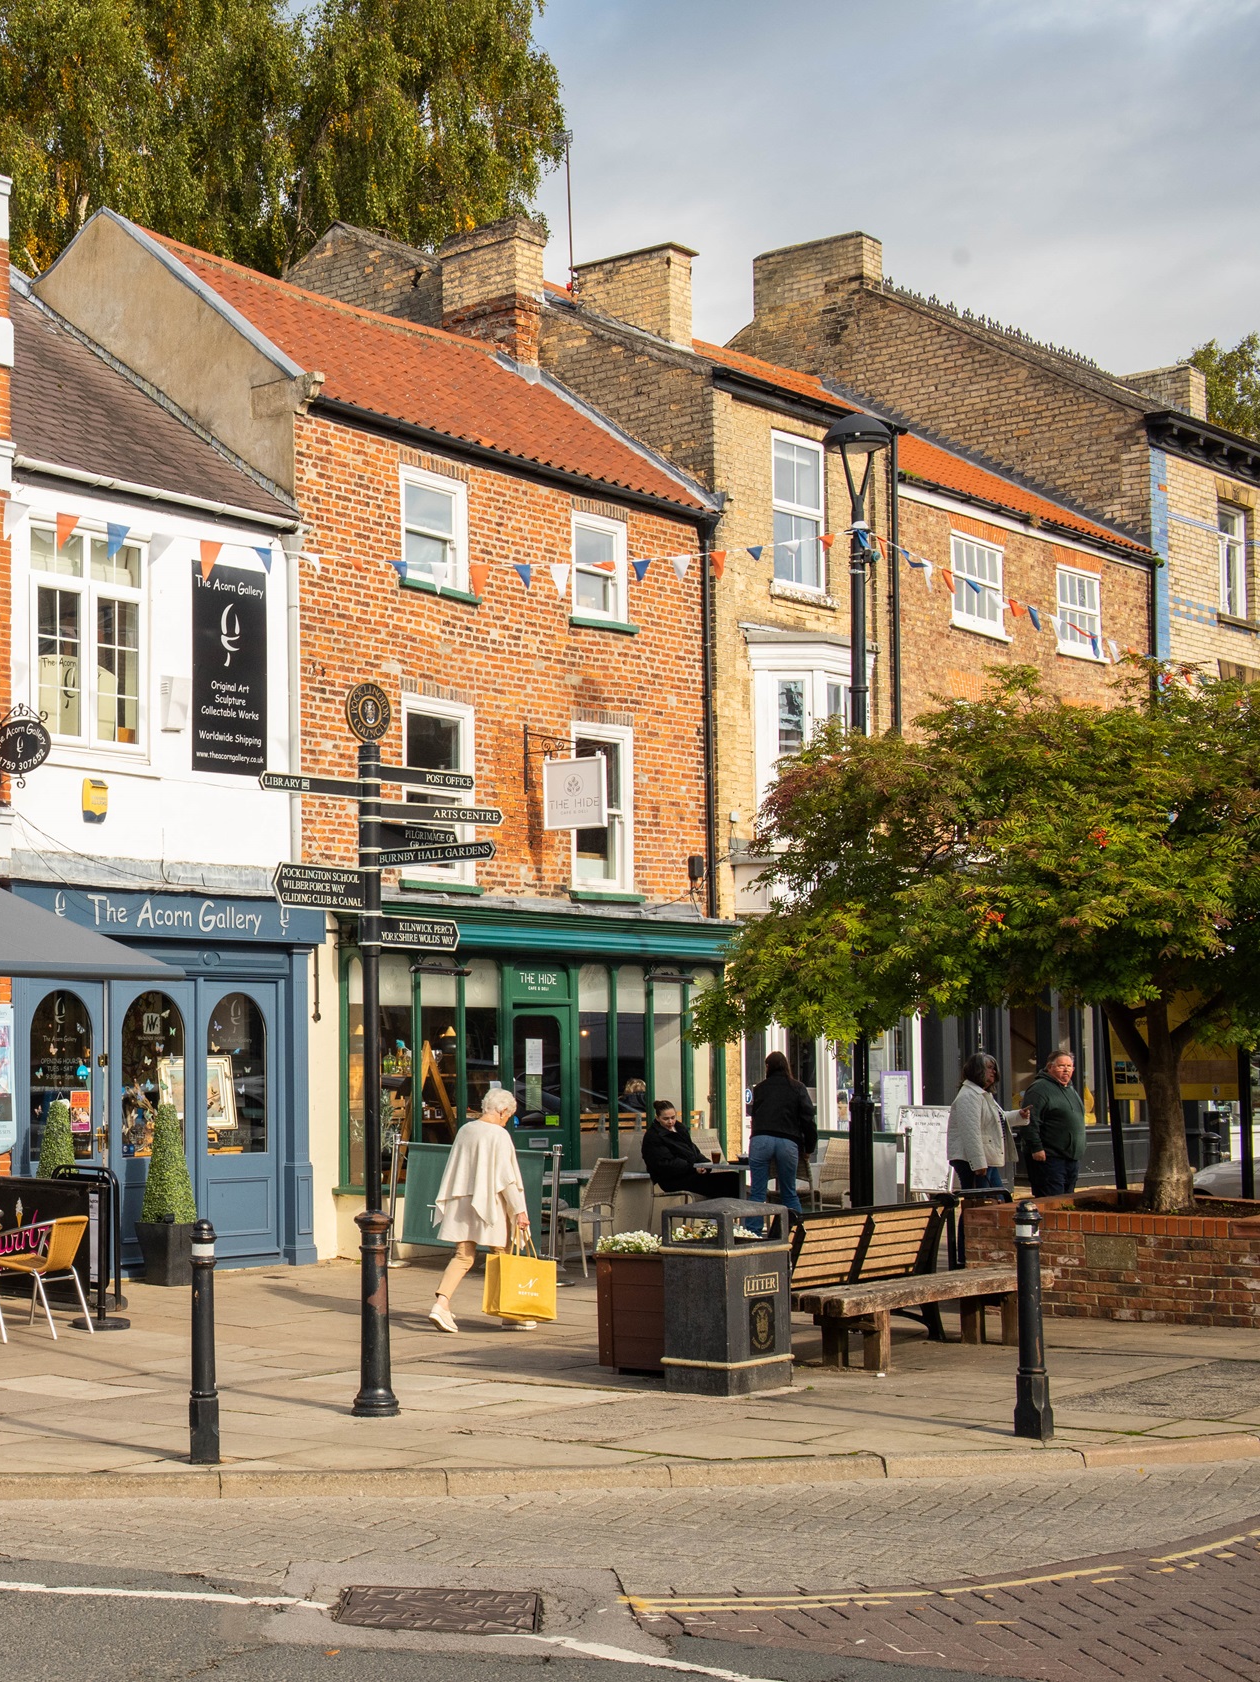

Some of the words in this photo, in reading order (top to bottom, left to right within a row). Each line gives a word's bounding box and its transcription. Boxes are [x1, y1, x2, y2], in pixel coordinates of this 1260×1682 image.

[195, 574, 211, 589] The
[213, 578, 236, 593] Acorn
[237, 581, 264, 599] Gallery
[41, 657, 56, 667] The
[59, 657, 77, 667] Acorn
[211, 680, 237, 693] Original
[238, 684, 250, 694] Art
[214, 694, 247, 706] Sculpture
[351, 685, 390, 719] POCKLINGTON
[201, 705, 237, 718] Collectable
[238, 710, 259, 721] Works
[6, 726, 25, 740] Acorn
[26, 723, 46, 745] Gallery
[354, 718, 388, 737] COUNCIL
[199, 729, 234, 743] Worldwide
[234, 734, 262, 748] Shipping
[18, 748, 46, 771] 307652
[196, 750, 264, 764] www.theacorngallery.co.uk
[264, 775, 301, 788] LIBRARY
[426, 773, 444, 784] POST
[445, 775, 472, 787] OFFICE
[549, 798, 570, 810] THE
[574, 796, 600, 808] HIDE
[433, 809, 458, 819] ARTS
[459, 810, 499, 821] CENTRE
[405, 829, 445, 841] PILGRIMAGE
[445, 834, 455, 843] OF
[379, 851, 416, 864] BURNBY
[417, 849, 444, 861] HALL
[444, 844, 490, 858] GARDENS
[281, 867, 332, 881] POCKLINGTON
[332, 872, 360, 884] SCHOOL
[281, 879, 331, 892] WILBERFORCE
[331, 883, 346, 894] WAY
[281, 891, 312, 904] GLIDING
[312, 894, 332, 905] CLUB
[332, 896, 338, 905] &
[338, 896, 363, 907] CANAL
[86, 893, 128, 926] The
[136, 898, 193, 929] Acorn
[198, 899, 262, 936] Gallery
[399, 922, 433, 933] KILNWICK
[433, 924, 454, 935] PERCY
[381, 931, 418, 943] YORKSHIRE
[418, 934, 440, 944] WOLDS
[441, 935, 454, 945] WAY
[519, 972, 536, 984] THE
[538, 973, 557, 985] HIDE
[63, 1034, 77, 1043] Gallery
[518, 1277, 538, 1289] N
[747, 1277, 776, 1292] LITTER
